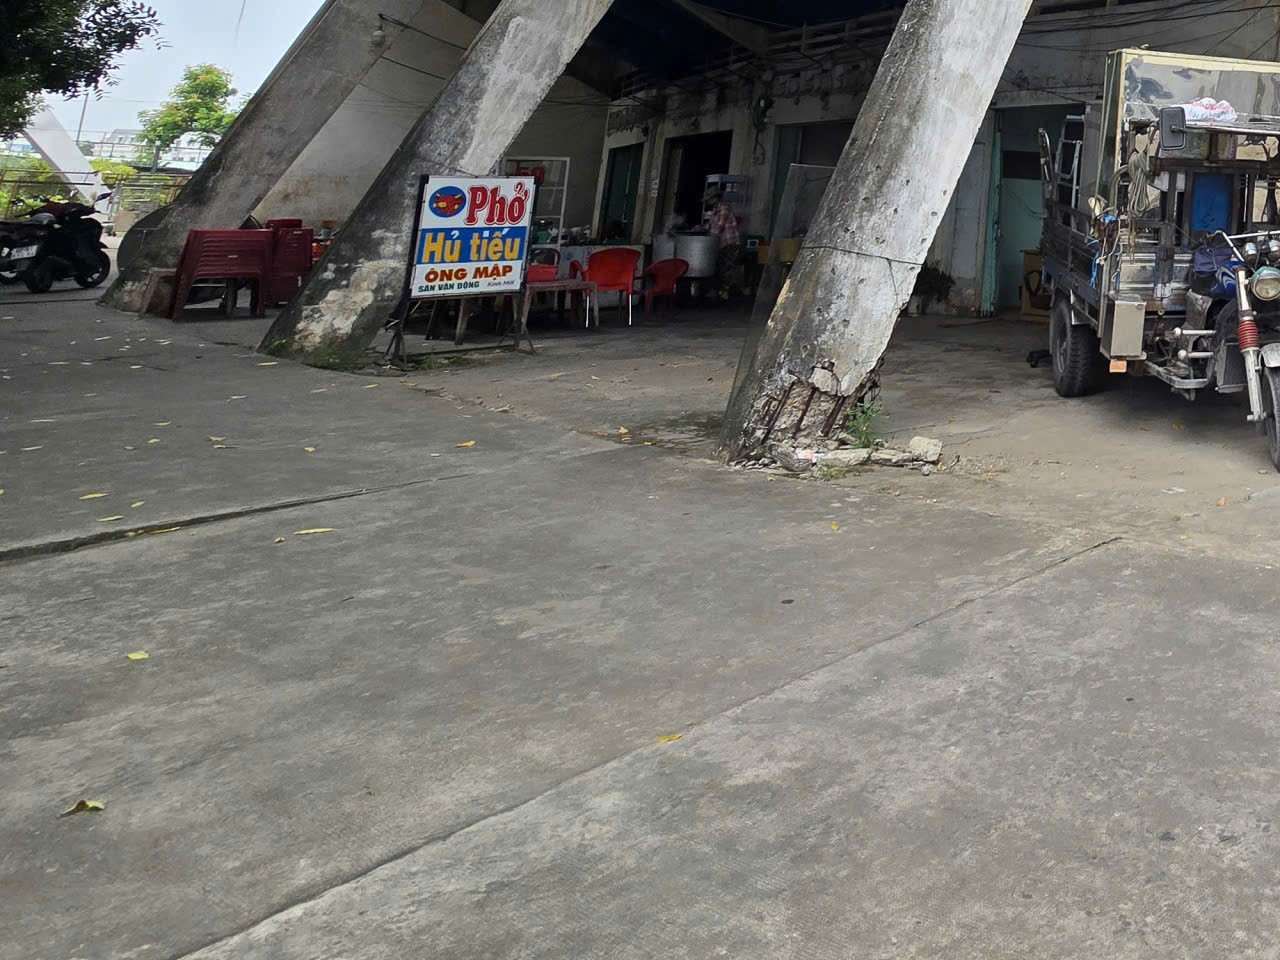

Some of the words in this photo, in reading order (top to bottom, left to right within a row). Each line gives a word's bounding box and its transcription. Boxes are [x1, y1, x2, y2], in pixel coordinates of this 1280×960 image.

[464, 181, 531, 226] Phở
[421, 230, 462, 263] Hủ
[470, 227, 520, 261] tiếu
[424, 267, 468, 283] ÔNG
[472, 264, 513, 281] MẬP
